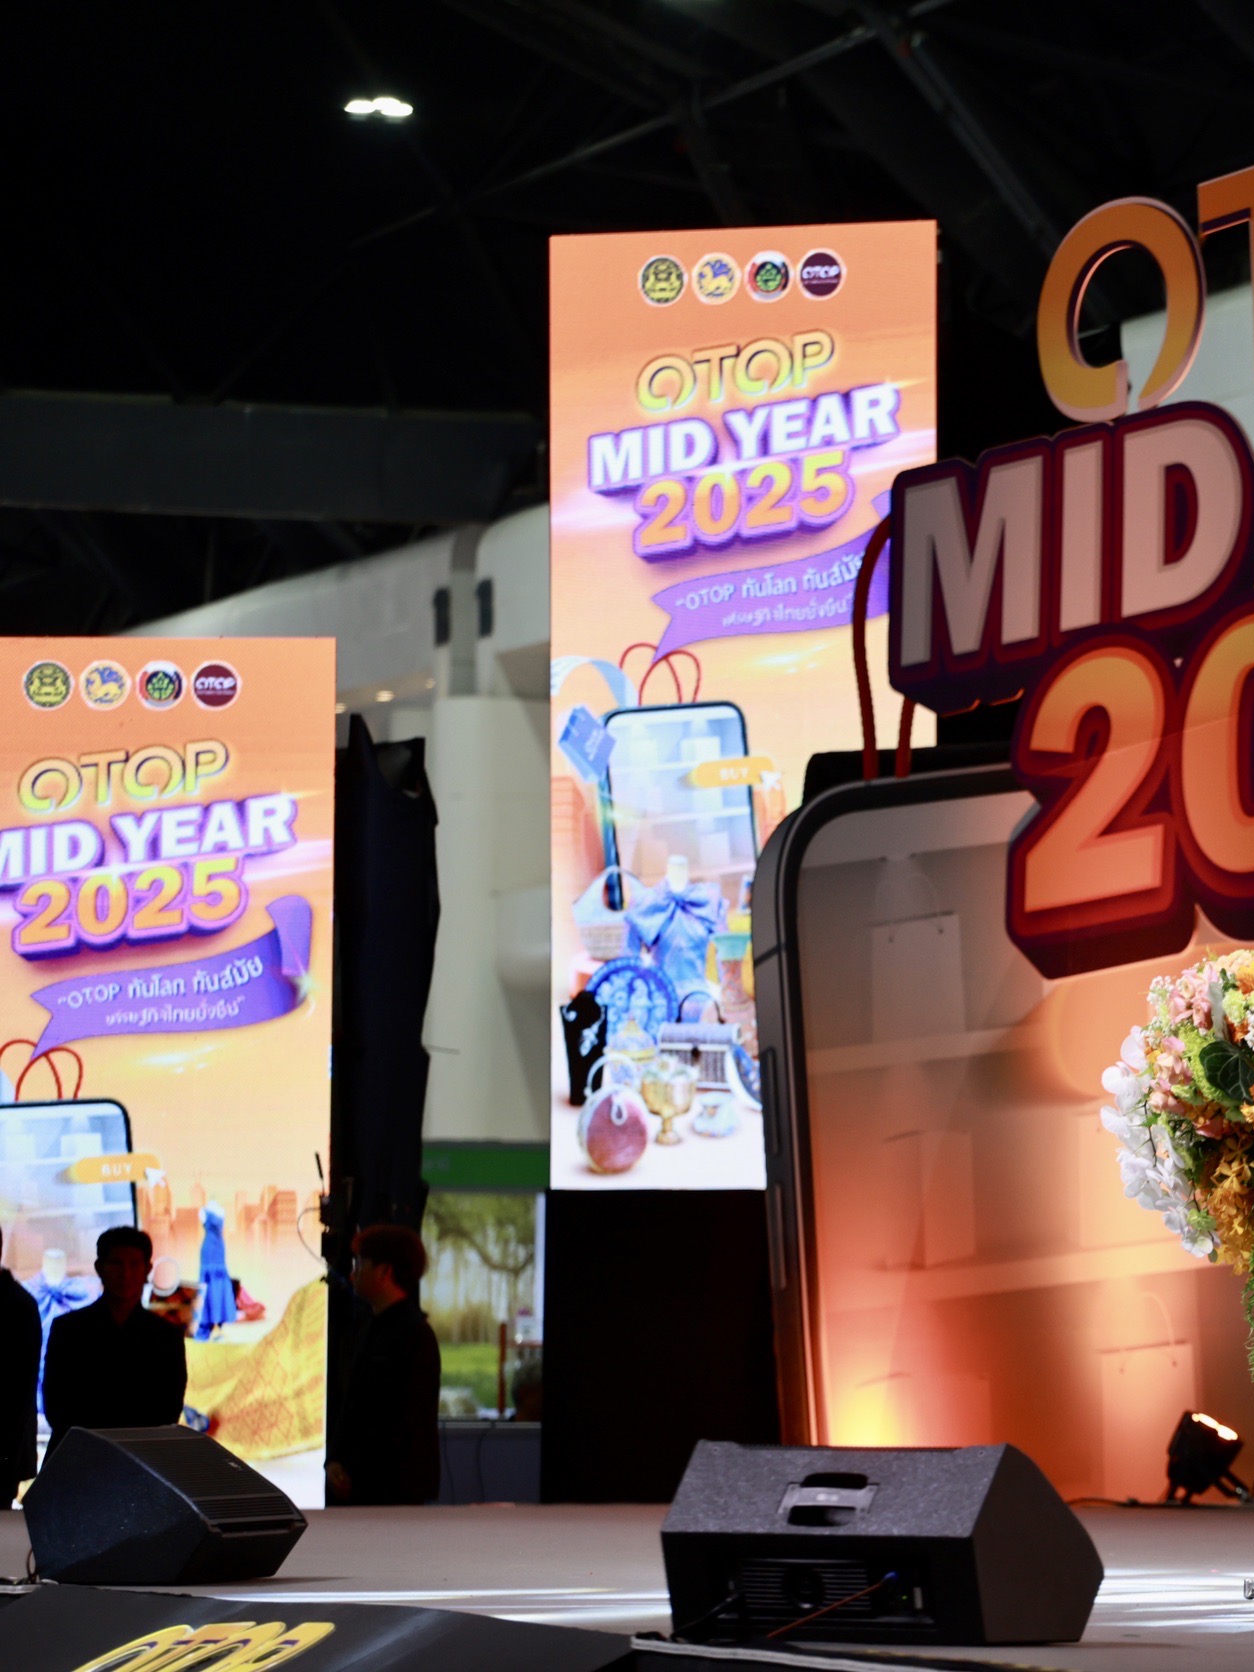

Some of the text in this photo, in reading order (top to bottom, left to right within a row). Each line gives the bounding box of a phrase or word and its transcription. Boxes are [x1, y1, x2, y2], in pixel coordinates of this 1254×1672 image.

[636, 330, 835, 412] OTOP
[590, 384, 900, 487] MID YEAR
[637, 450, 851, 548] 2025
[898, 412, 1246, 668] MID
[17, 739, 230, 814] OTOP
[720, 765, 750, 781] BUY
[112, 796, 296, 864] YEAR
[18, 856, 241, 946] 2025
[101, 1162, 133, 1177] BUY
